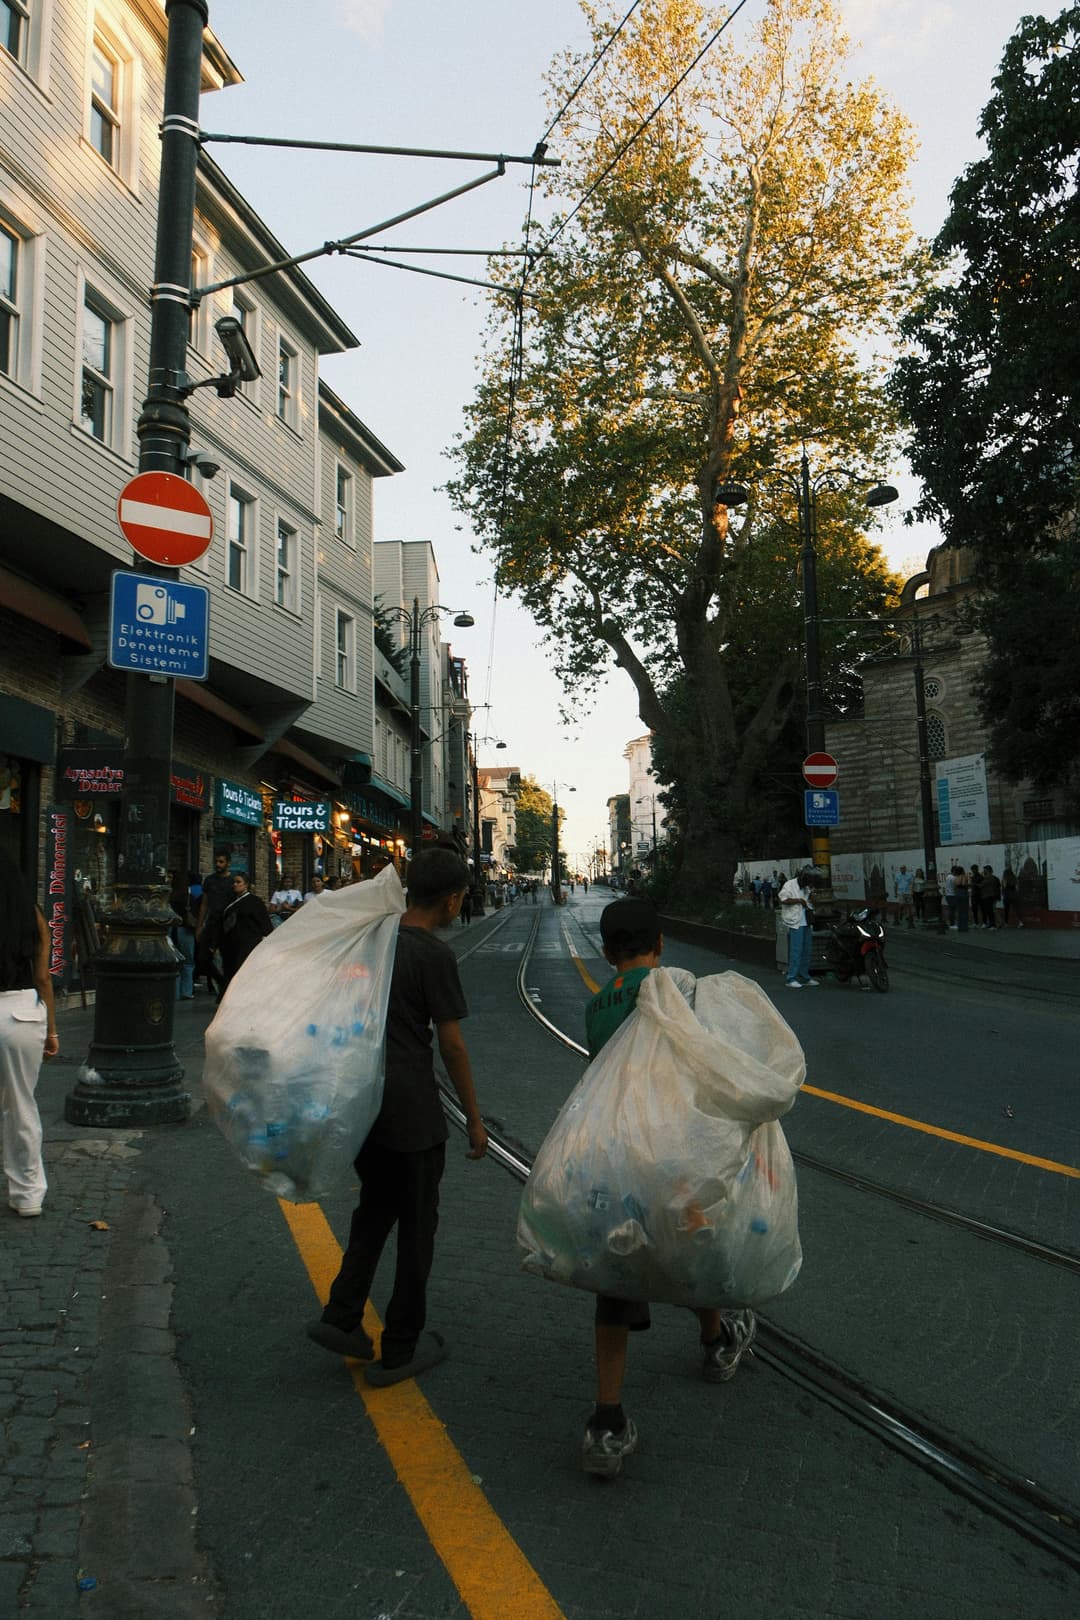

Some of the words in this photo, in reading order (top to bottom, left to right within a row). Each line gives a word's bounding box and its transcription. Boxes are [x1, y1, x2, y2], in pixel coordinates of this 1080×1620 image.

[120, 624, 199, 645] Elektronik
[118, 637, 200, 658] Denetleme
[130, 653, 187, 670] Sistemi
[64, 766, 125, 782] Ayasofya
[222, 782, 239, 803] Tours
[277, 803, 313, 816] Tours
[315, 804, 326, 816] &
[276, 816, 326, 830] Tickets
[50, 813, 67, 896] Dönercisi
[49, 901, 68, 977] Ayasofya
